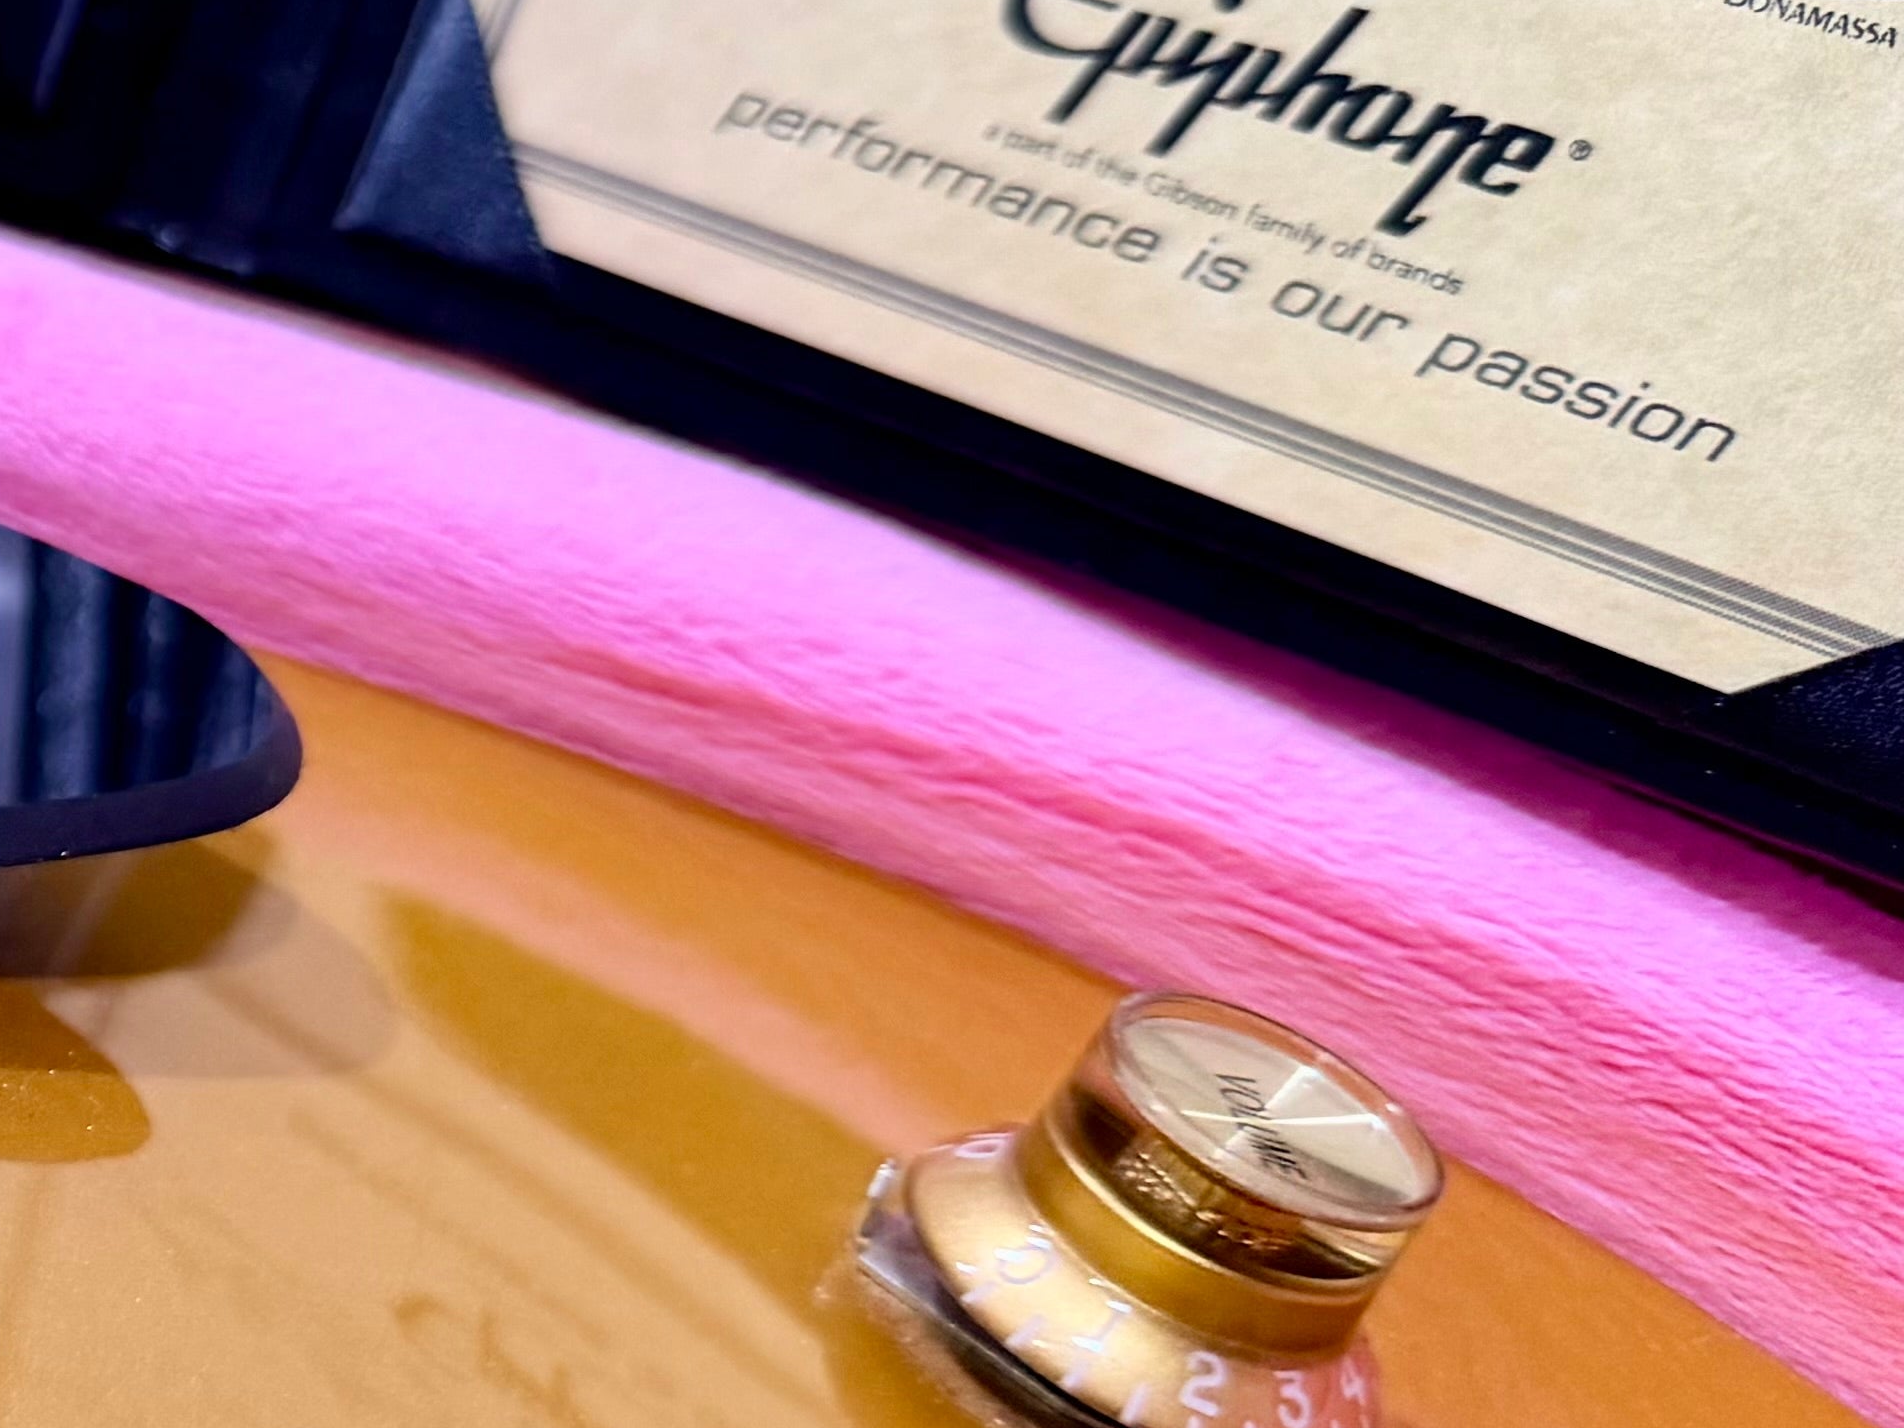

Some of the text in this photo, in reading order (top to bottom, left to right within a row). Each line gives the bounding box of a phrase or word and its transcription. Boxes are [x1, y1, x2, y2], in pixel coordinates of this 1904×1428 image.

[715, 91, 1737, 463] performance is our passion
[1002, 128, 1058, 163] part
[1061, 139, 1092, 168] of
[1095, 148, 1138, 186] the
[1143, 171, 1240, 220] Gibson
[1244, 202, 1326, 253] family
[1331, 236, 1366, 261] of
[1366, 249, 1464, 296] brands
[1180, 1351, 1228, 1418] 2
[1340, 1360, 1368, 1407] 4
